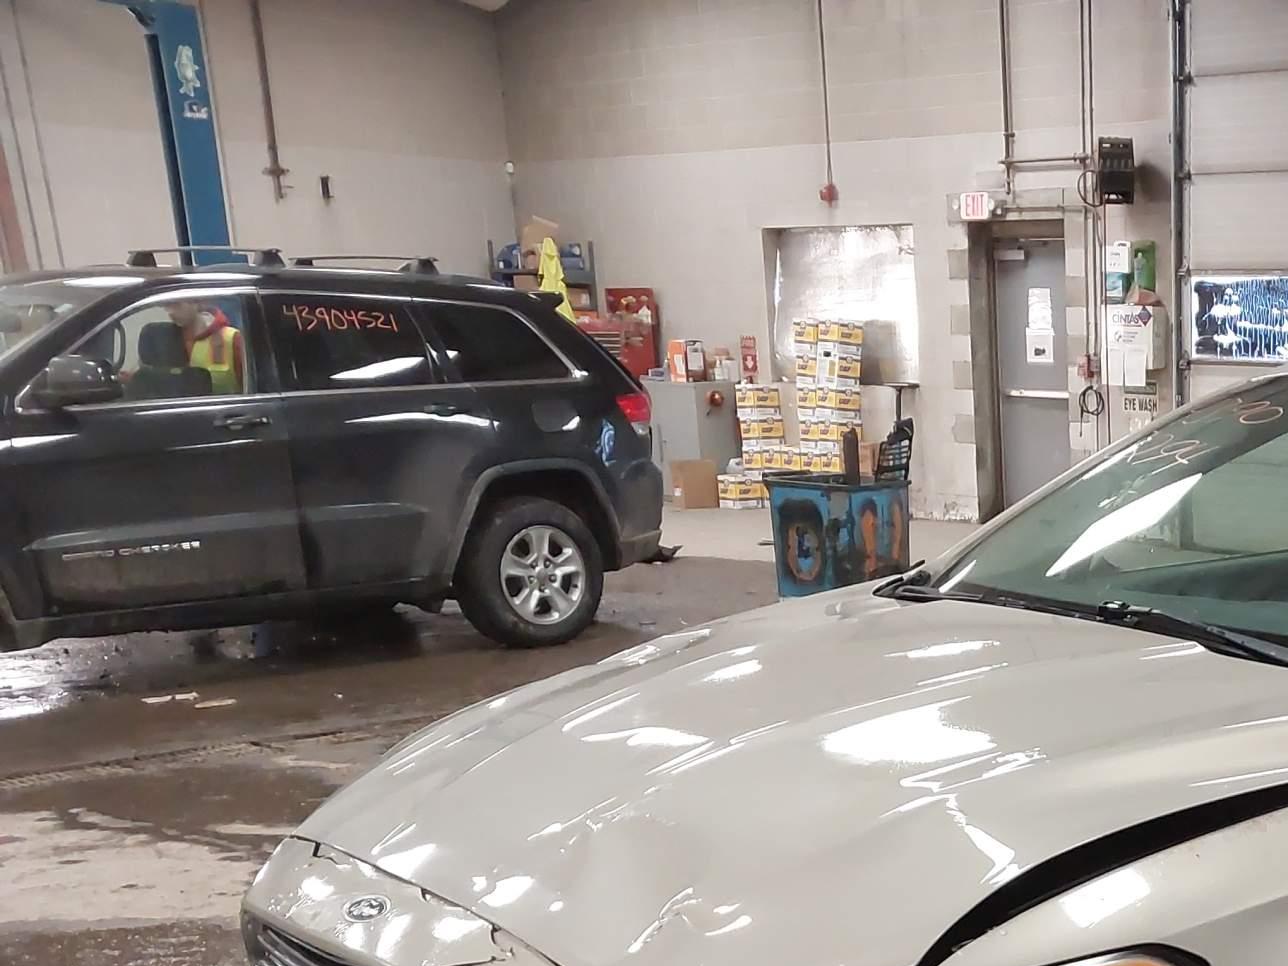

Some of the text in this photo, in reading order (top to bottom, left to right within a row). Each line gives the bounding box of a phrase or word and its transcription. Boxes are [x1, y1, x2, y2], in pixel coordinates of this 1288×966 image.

[965, 194, 985, 217] EXIT
[283, 304, 398, 332] 43904521
[1124, 397, 1158, 413] EYE WASH
